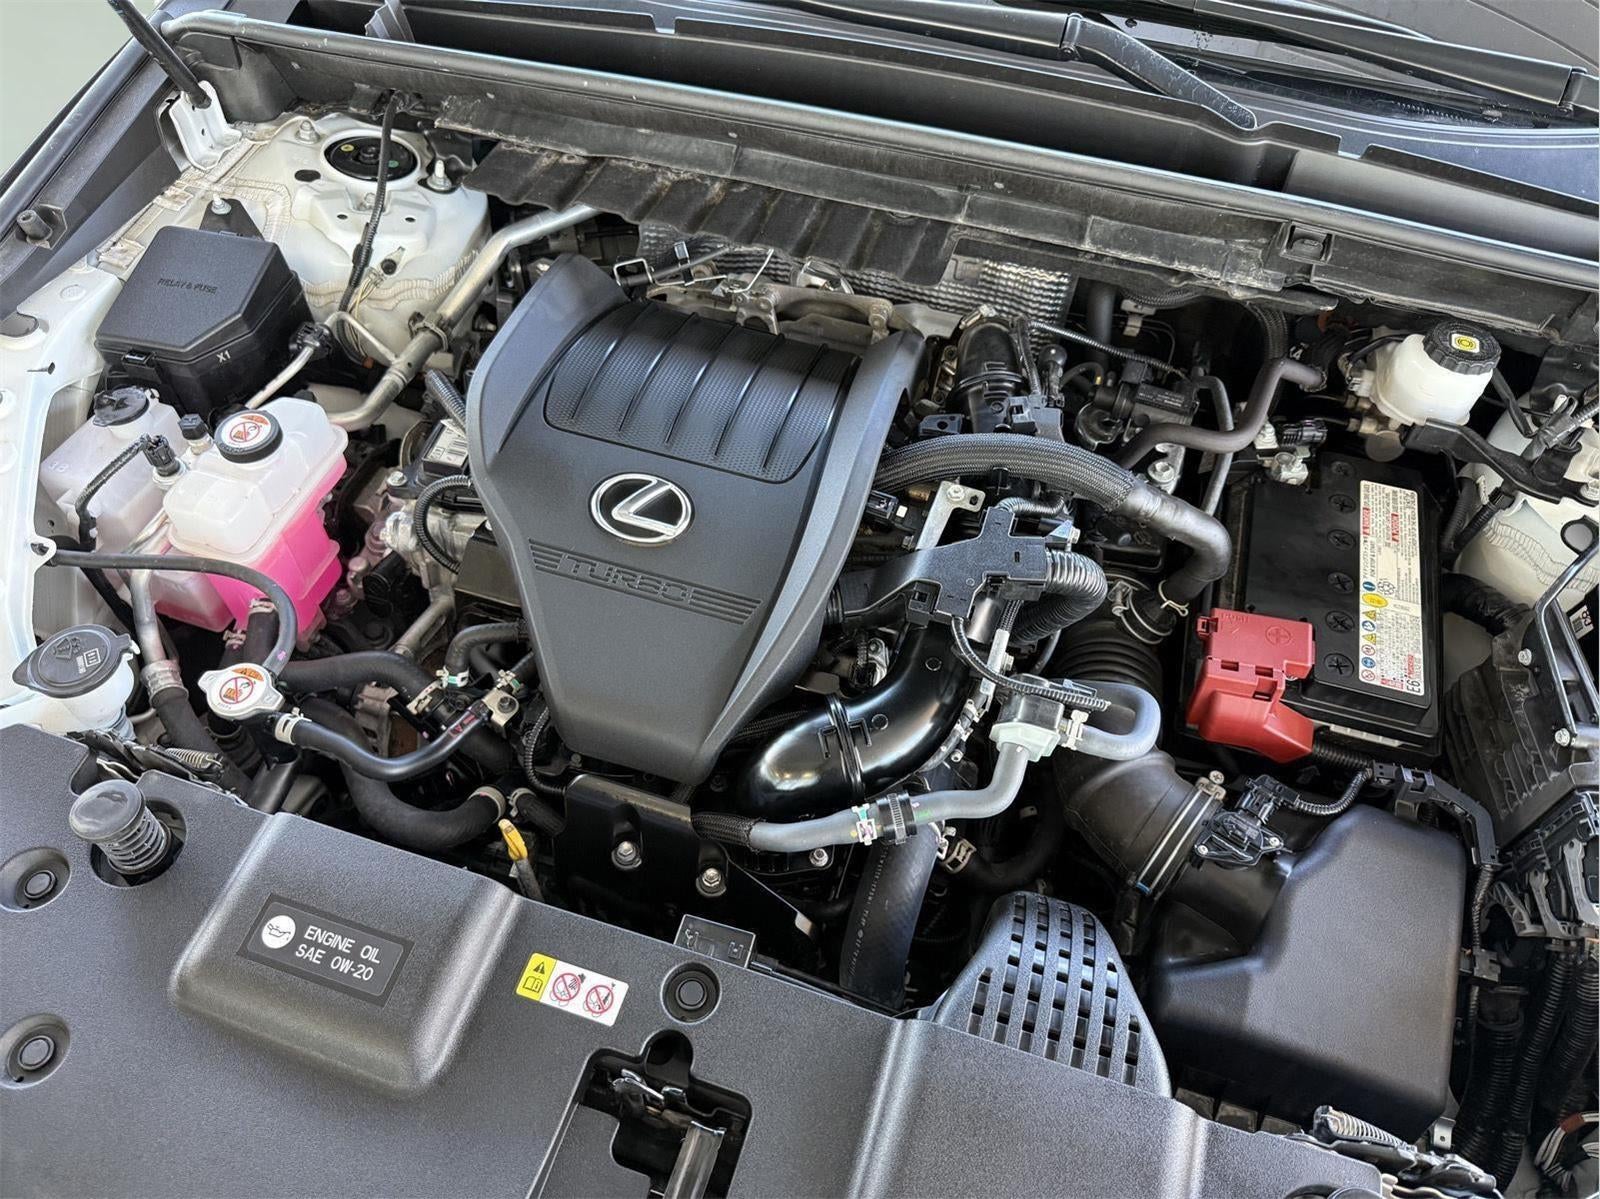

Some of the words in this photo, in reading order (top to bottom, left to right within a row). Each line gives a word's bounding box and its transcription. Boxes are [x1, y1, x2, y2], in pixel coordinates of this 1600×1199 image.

[193, 283, 218, 294] FUSE
[216, 350, 231, 363] X1
[565, 555, 688, 601] TURBO
[1407, 680, 1420, 692] E6
[304, 925, 356, 953] ENGINE
[360, 945, 381, 964] OIL
[295, 944, 325, 964] SAE
[330, 956, 374, 981] 0W-20
